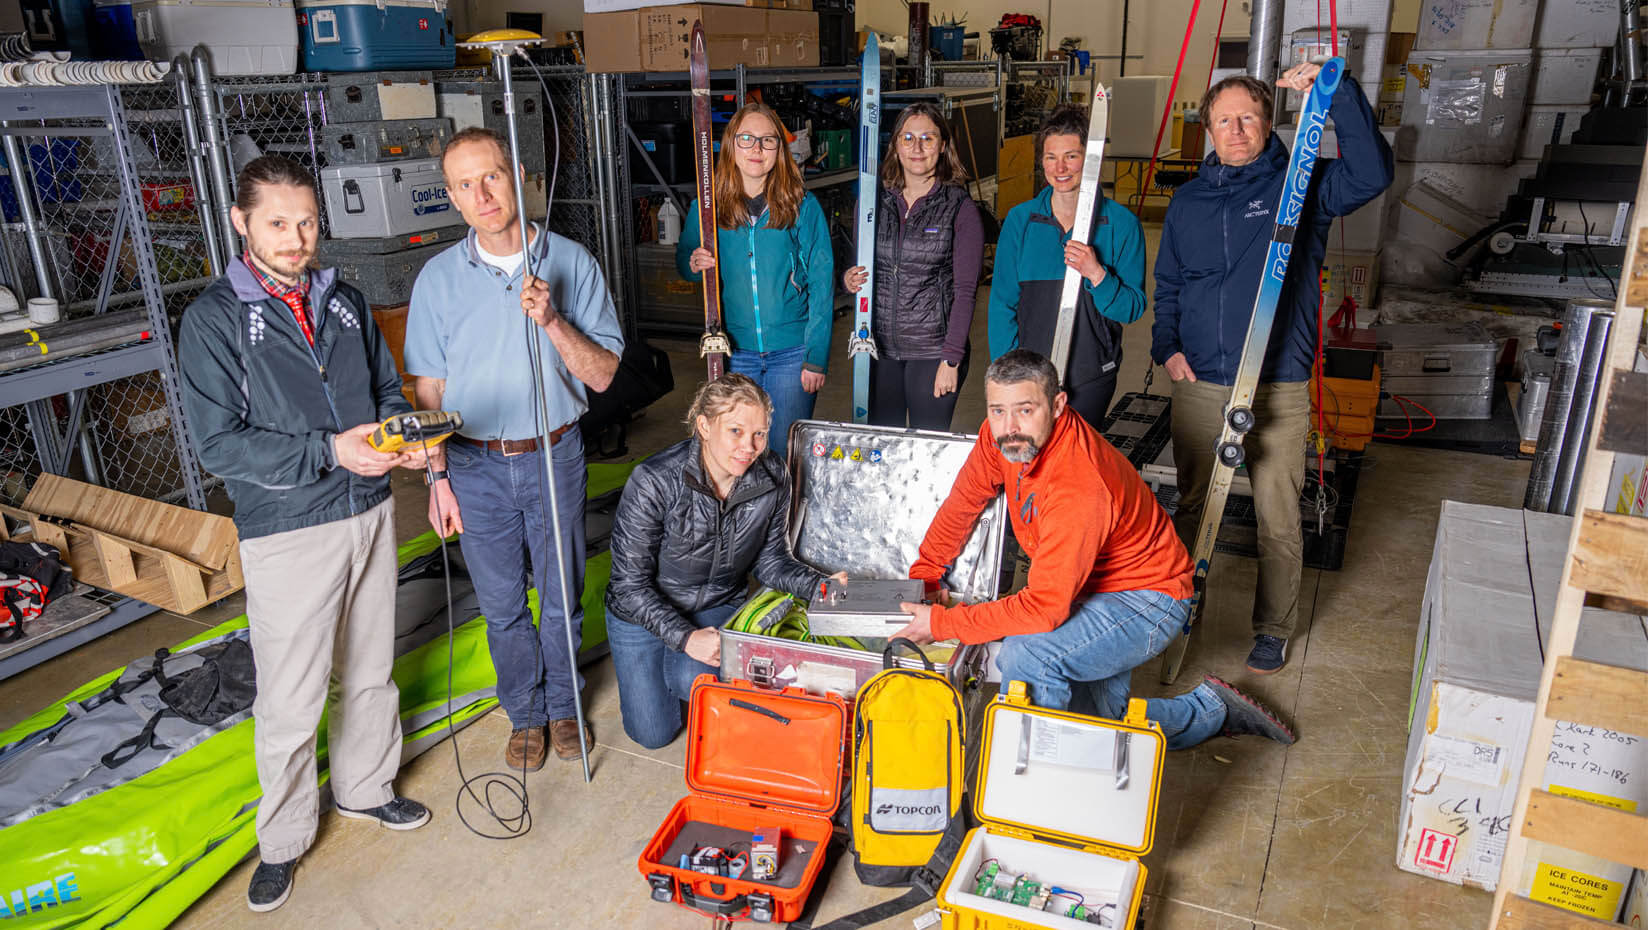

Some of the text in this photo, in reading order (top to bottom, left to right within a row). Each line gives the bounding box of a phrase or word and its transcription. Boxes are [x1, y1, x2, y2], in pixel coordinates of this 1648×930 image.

[412, 187, 448, 203] Cool-Ice
[895, 804, 942, 816] TOPCON
[1549, 869, 1609, 891] ICE CORES
[1549, 881, 1603, 899] MAINTAIN TEMP
[1547, 896, 1596, 913] KEEP FROZEN
